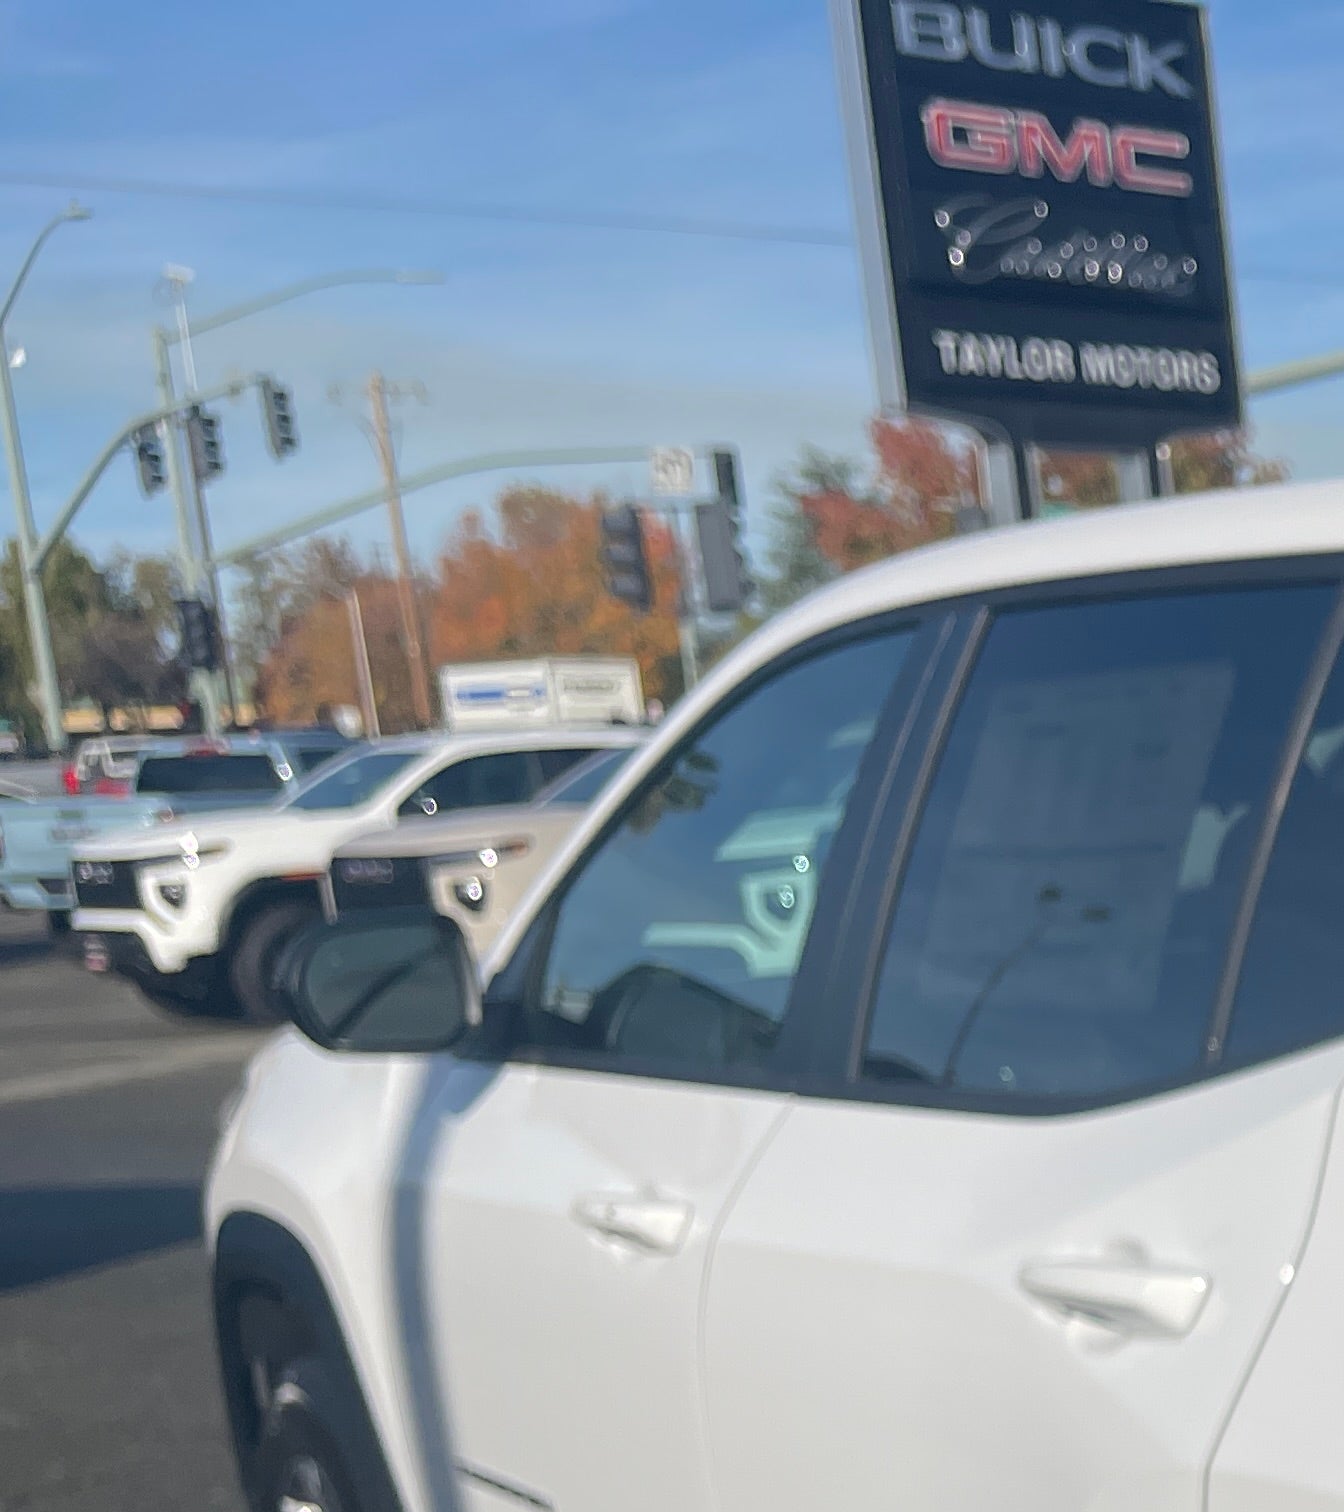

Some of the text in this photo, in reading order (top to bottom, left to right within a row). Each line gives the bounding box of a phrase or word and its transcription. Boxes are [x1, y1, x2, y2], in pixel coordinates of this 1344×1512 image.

[892, 1, 1195, 99] BUICK
[920, 97, 1194, 196] GMC
[932, 329, 1221, 395] TAYLOR MOTORS
